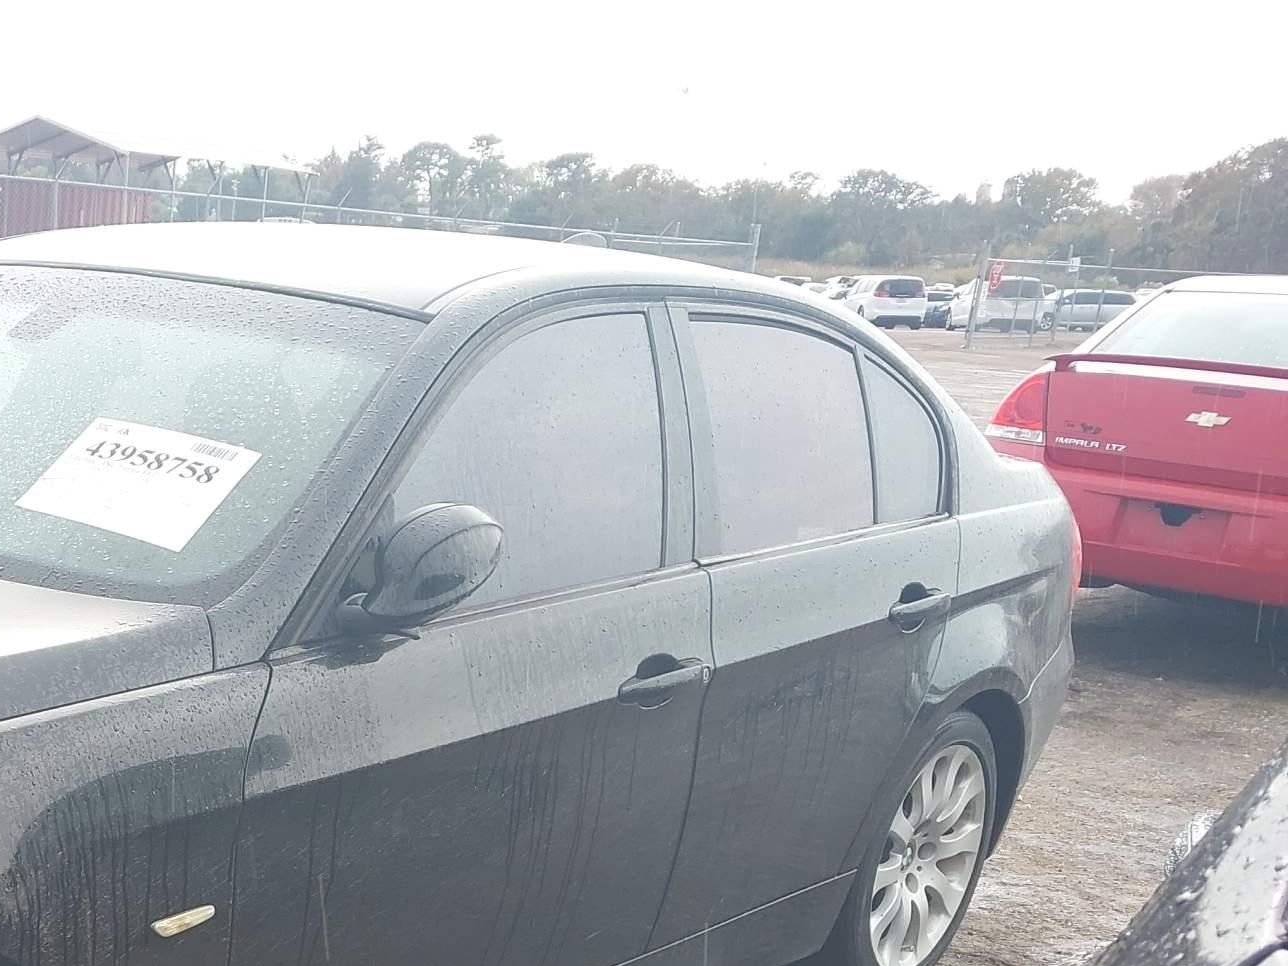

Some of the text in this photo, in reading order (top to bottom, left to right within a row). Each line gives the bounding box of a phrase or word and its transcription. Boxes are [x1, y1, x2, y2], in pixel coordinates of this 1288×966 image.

[1055, 436, 1127, 452] IMPALA LTZ
[86, 440, 220, 483] 43958758
